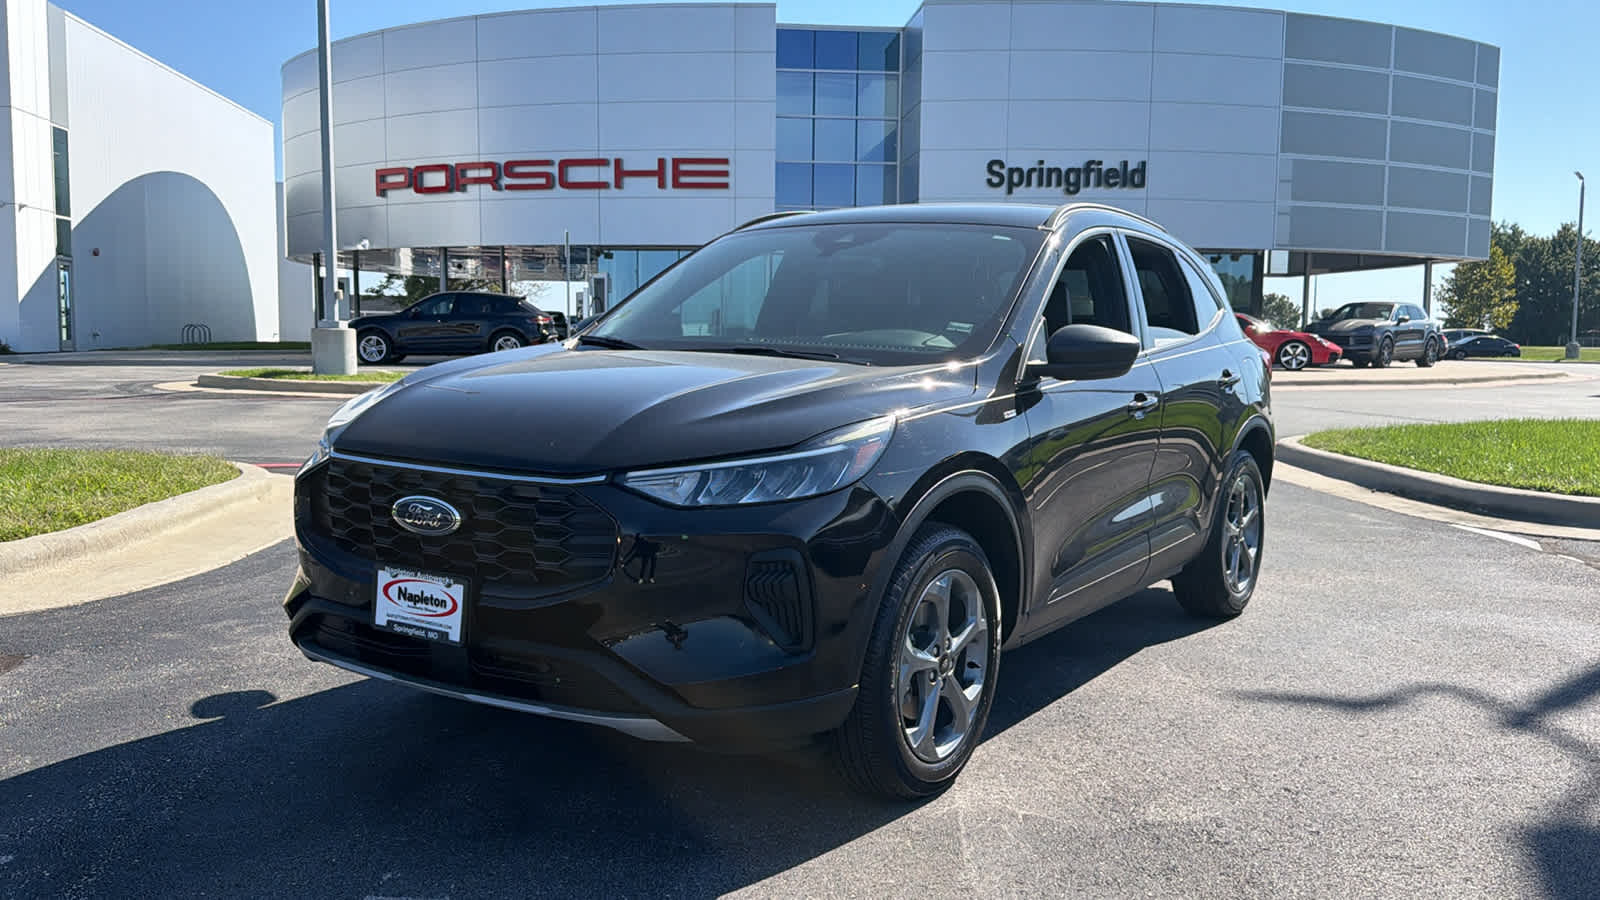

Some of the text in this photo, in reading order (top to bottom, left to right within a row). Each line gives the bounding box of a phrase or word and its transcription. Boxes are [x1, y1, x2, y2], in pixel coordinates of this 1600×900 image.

[375, 157, 730, 198] PORSCHE
[986, 159, 1147, 196] Springfield
[403, 501, 452, 529] Ford
[397, 585, 448, 609] Napleton
[427, 631, 439, 640] MO
